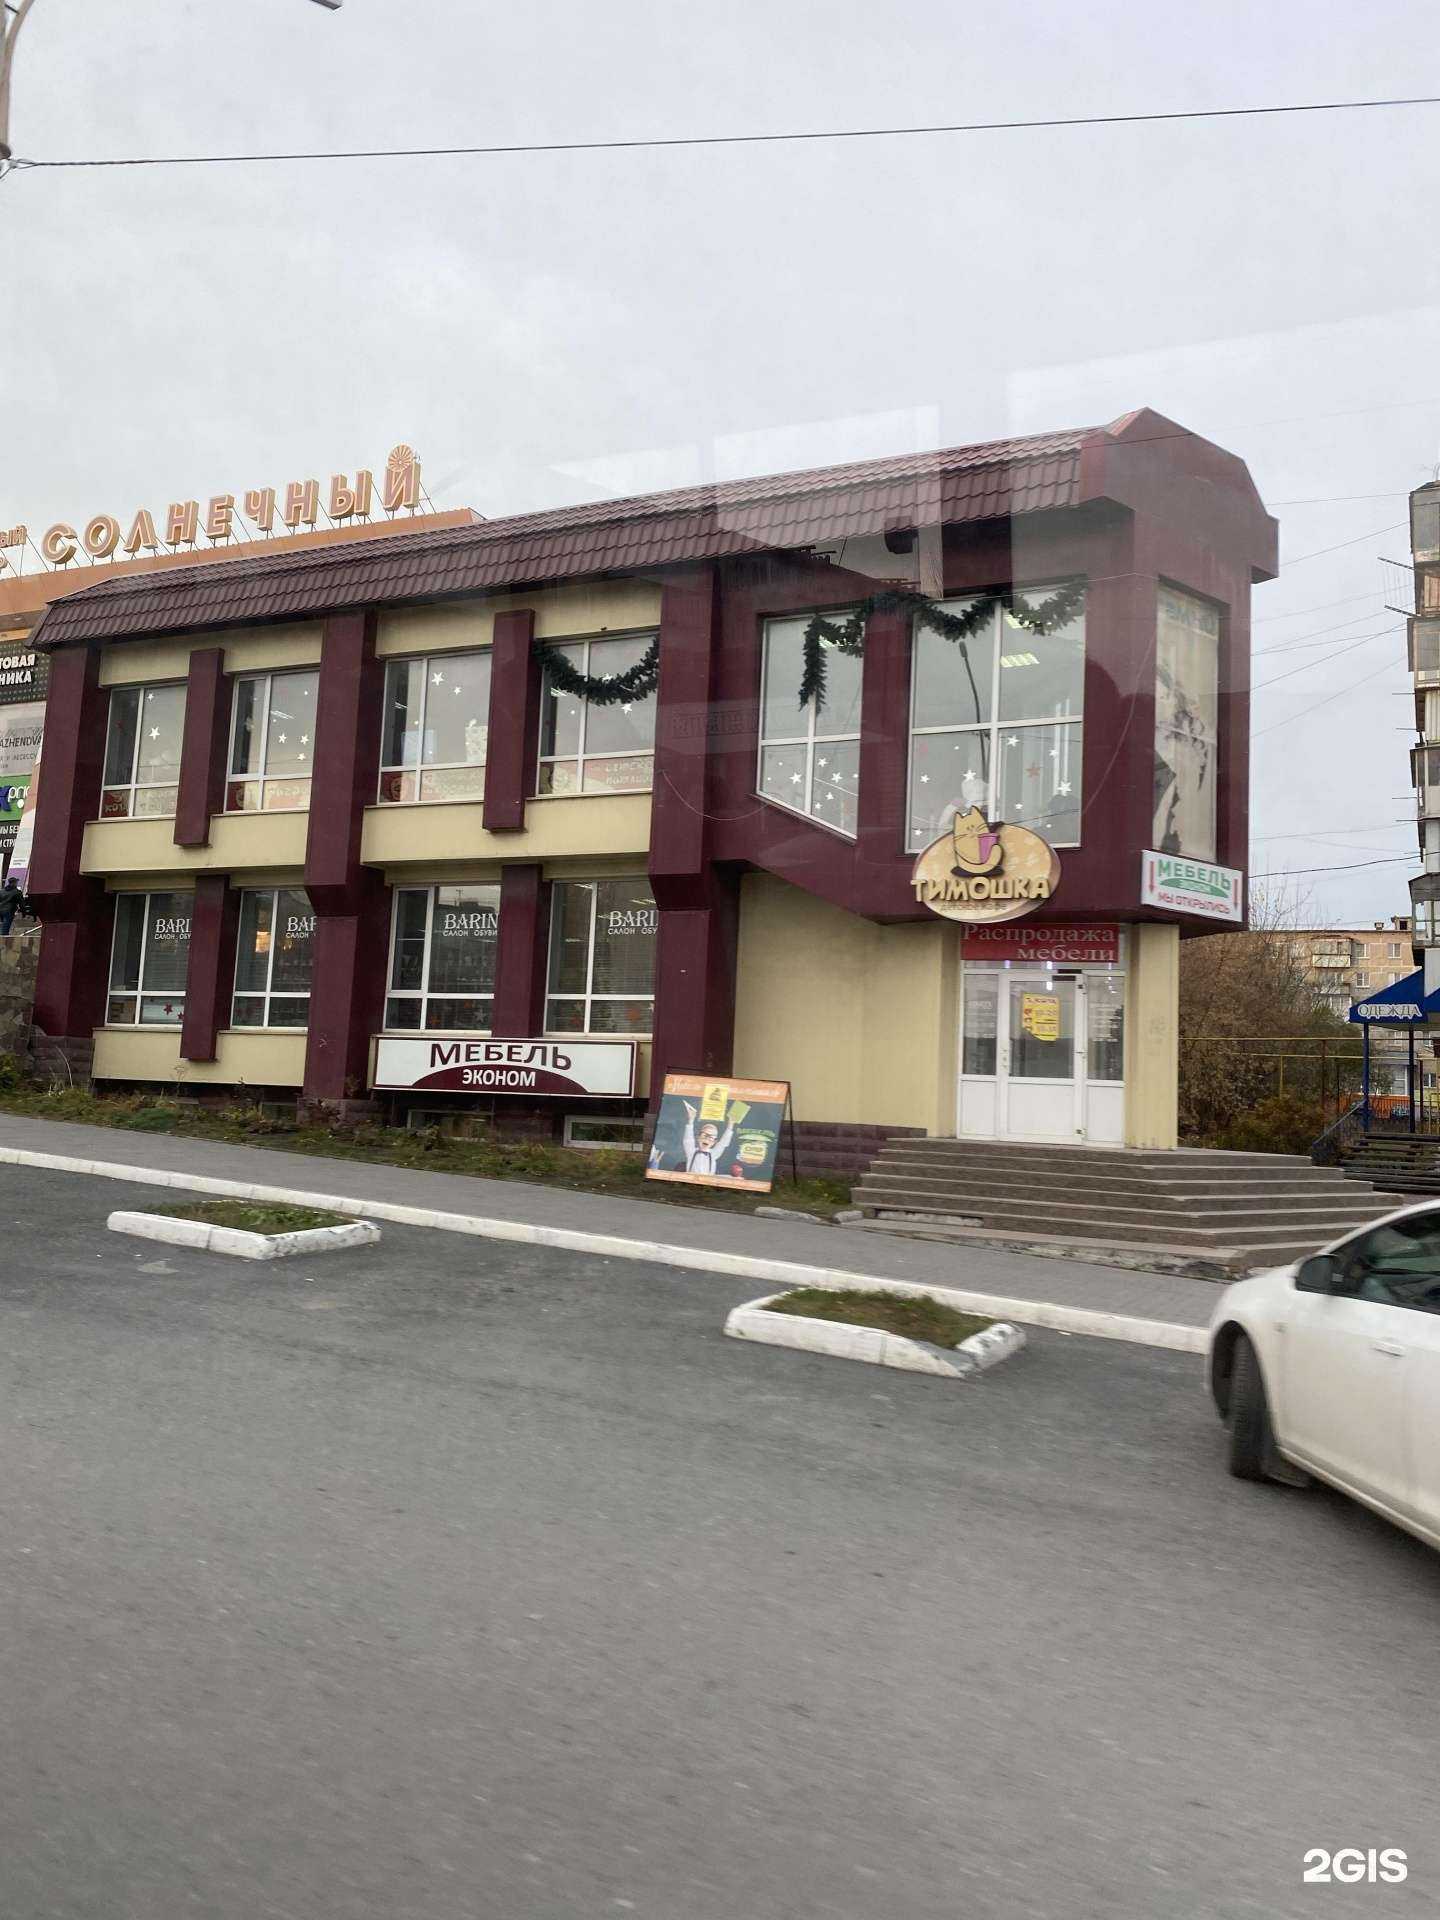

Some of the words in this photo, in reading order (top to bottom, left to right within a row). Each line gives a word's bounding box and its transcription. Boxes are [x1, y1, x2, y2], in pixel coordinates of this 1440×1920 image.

[42, 444, 422, 565] СОЛНЕЧНЫЙ
[1157, 859, 1231, 891] МЕБЕЛЬ
[910, 875, 1051, 903] ТИМОШКА
[609, 909, 659, 927] BARI
[961, 923, 1116, 946] Распродажа
[1017, 944, 1115, 961] мебели
[1357, 1004, 1423, 1020] ОДЕЖДА
[430, 1043, 572, 1071] МЕБЕЛЬ
[461, 1069, 536, 1087] ЭКОНОМ
